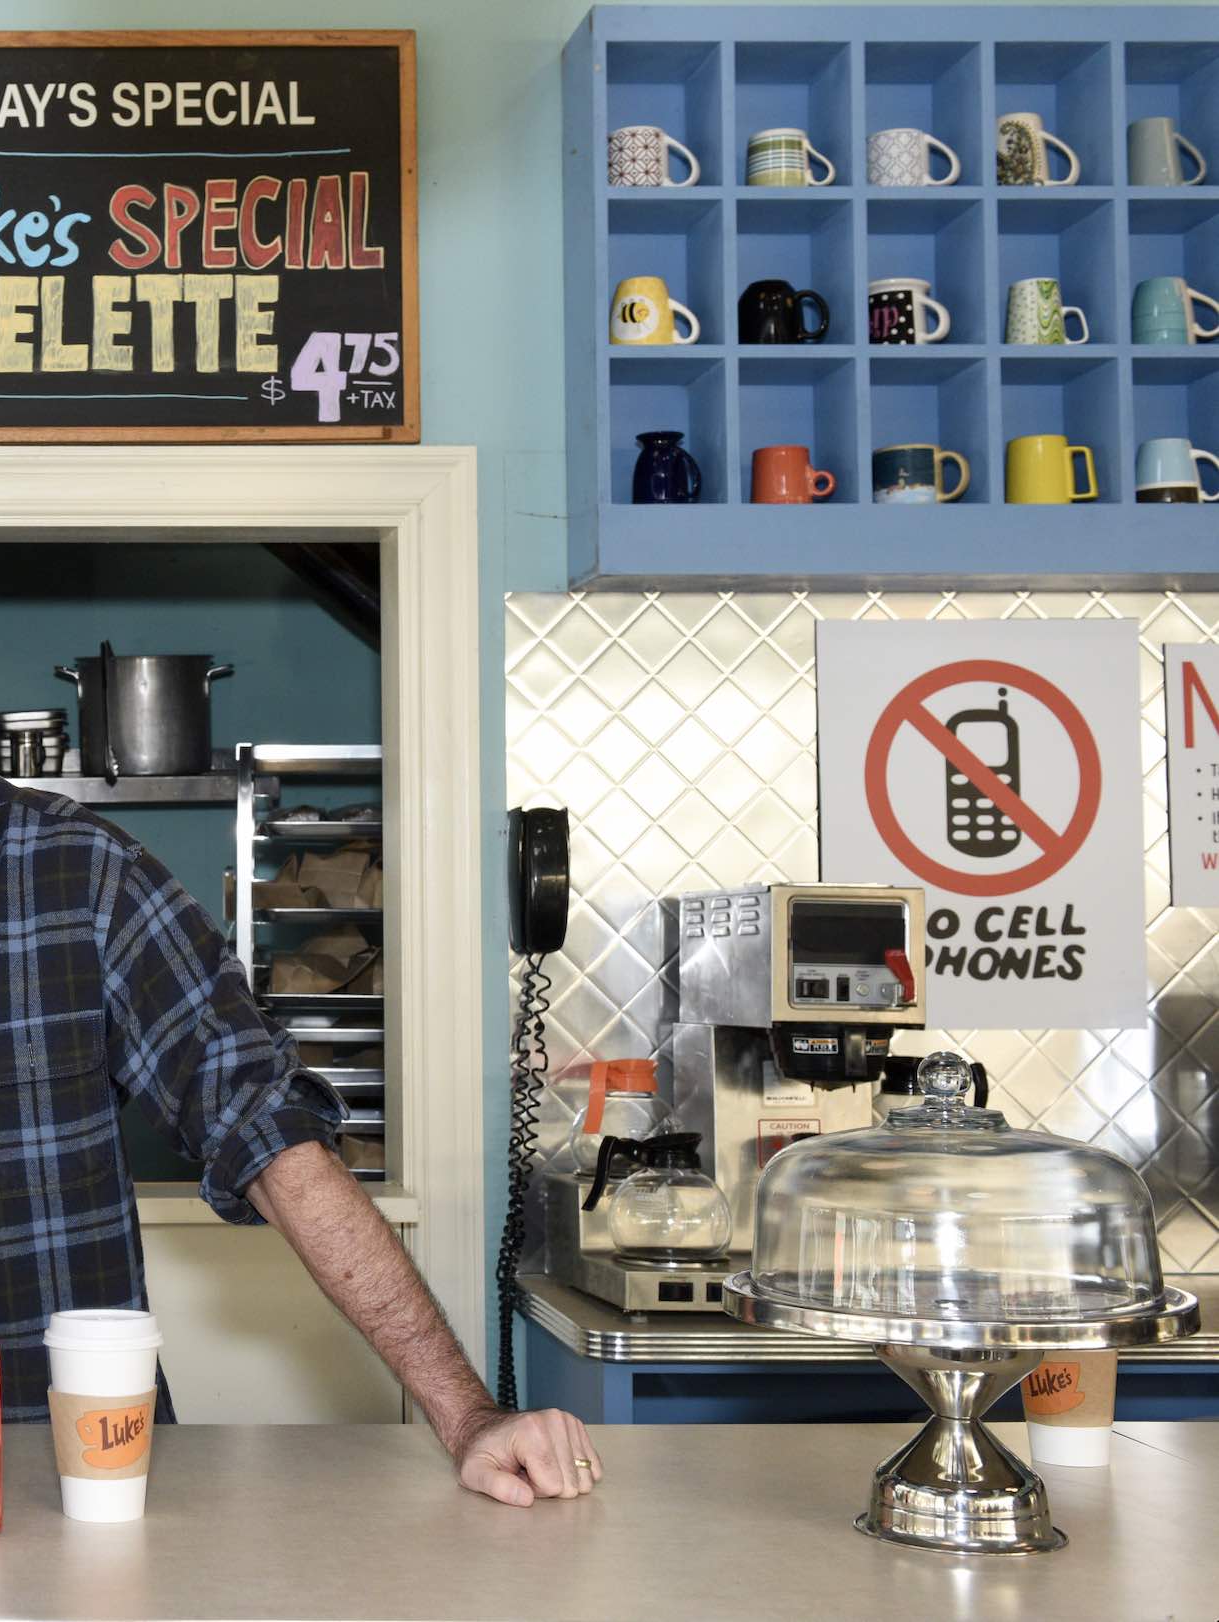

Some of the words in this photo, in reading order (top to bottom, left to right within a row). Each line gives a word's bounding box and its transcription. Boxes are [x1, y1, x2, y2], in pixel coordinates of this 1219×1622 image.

[111, 80, 316, 127] SPECIAL
[108, 171, 385, 271] SPECIAL
[926, 908, 960, 940] O
[974, 903, 1087, 940] CELL
